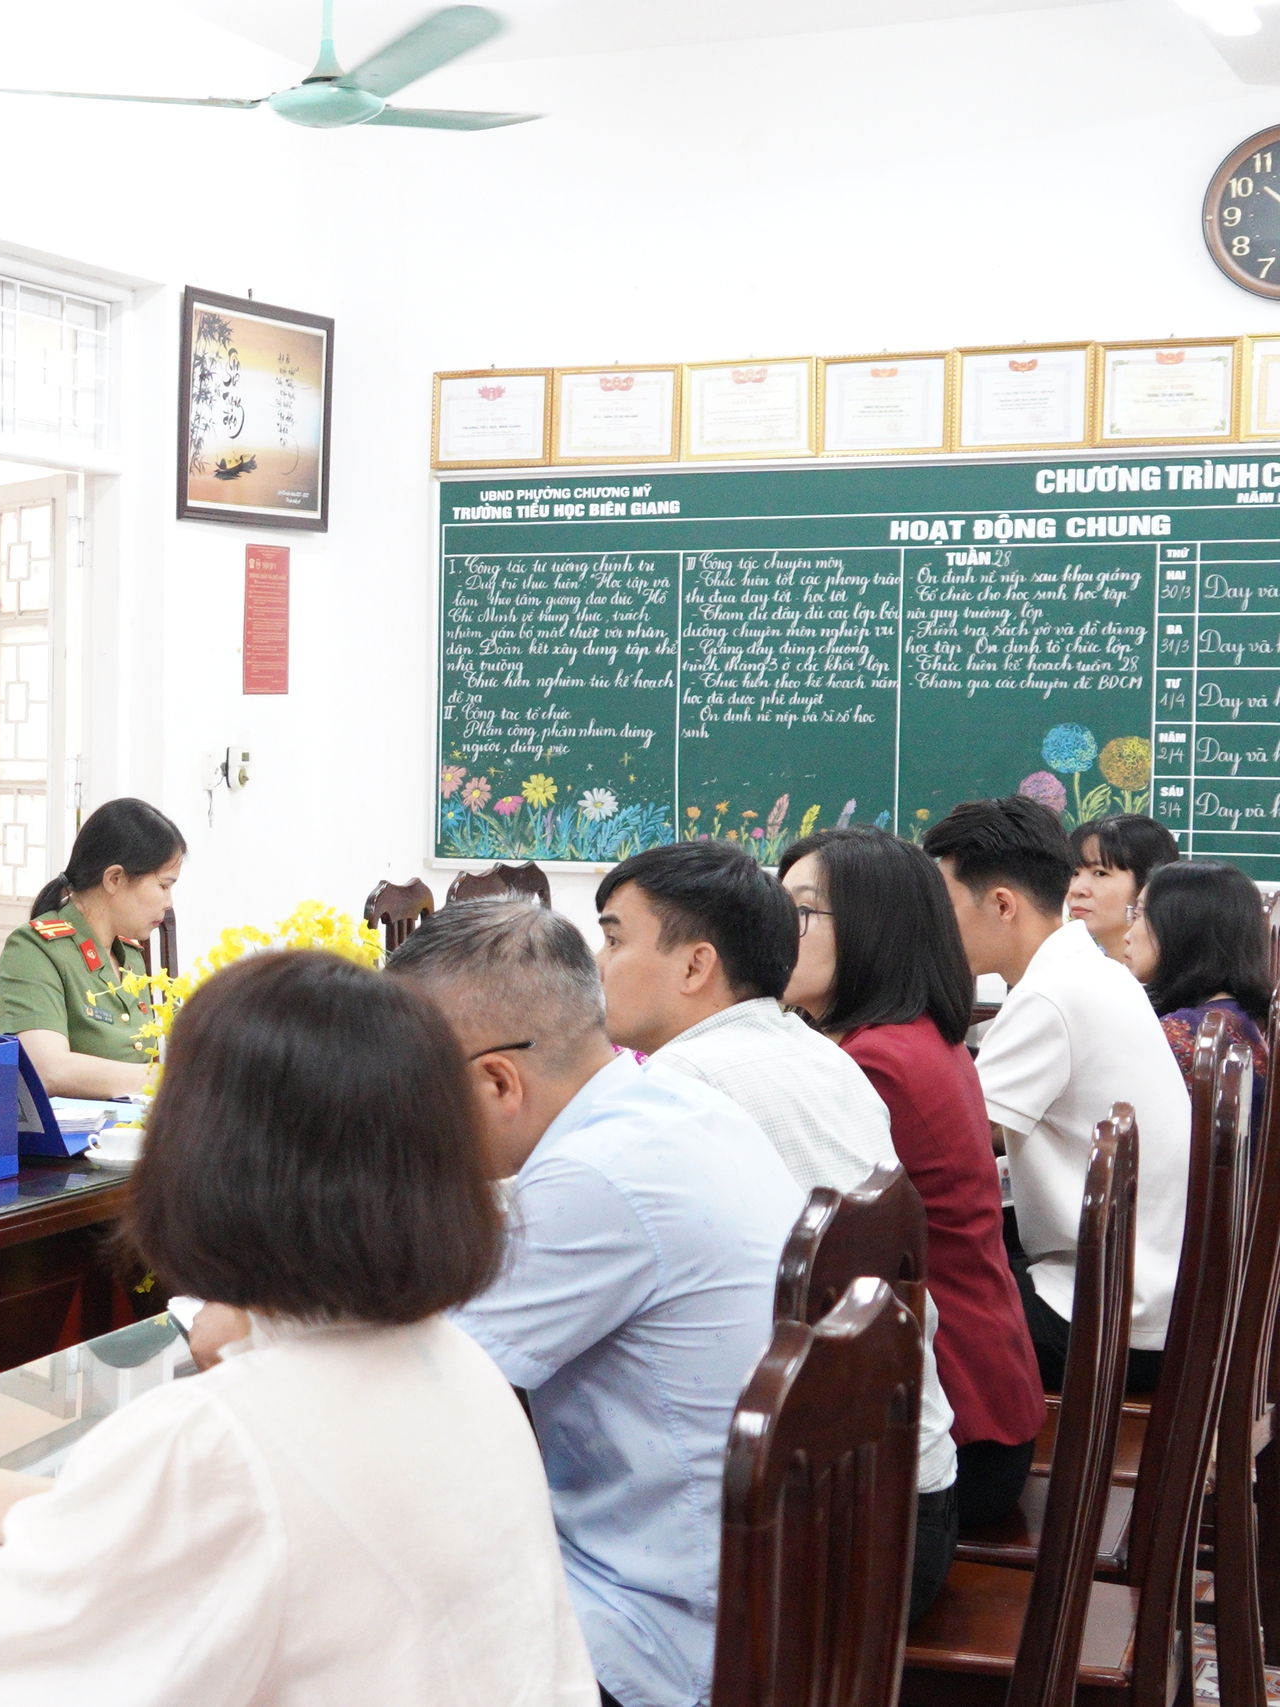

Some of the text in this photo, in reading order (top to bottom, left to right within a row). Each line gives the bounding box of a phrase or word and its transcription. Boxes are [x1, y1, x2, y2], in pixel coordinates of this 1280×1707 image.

[1253, 151, 1272, 174] 11
[1229, 177, 1254, 198] 10
[1222, 206, 1242, 227] 9
[1232, 235, 1250, 256] 8
[1257, 257, 1276, 279] 7
[1036, 465, 1161, 494] CHƯƠNG
[1164, 459, 1259, 490] TRÌNH
[480, 483, 652, 502] UBND PHƯỜNG CHƯƠNG MỸ
[1236, 491, 1273, 504] NĂM
[452, 499, 680, 520] TRƯỜNG TIỂU HỌC BIÊN GIANG
[890, 514, 1171, 545] HOẠT ĐỘNG CHUNG
[945, 548, 1012, 567] TUẦN 28
[1166, 547, 1190, 558] THỨ
[465, 555, 502, 582] Công
[506, 560, 528, 574] tác
[532, 560, 548, 574] tư
[593, 554, 635, 572] chính
[638, 560, 656, 575] trị
[699, 552, 733, 579] Công
[738, 556, 761, 570] tác
[816, 556, 846, 569] môn
[1031, 564, 1094, 583] sau khai
[1166, 570, 1186, 580] HAI
[653, 576, 671, 588] và
[800, 567, 871, 595] các phong
[642, 588, 669, 605] Hồ
[685, 587, 737, 604] thi đua
[940, 584, 1069, 601] chức cho sinh
[1160, 584, 1191, 602] 30/3
[546, 596, 582, 614] gương
[448, 606, 651, 631] Chí Minh về trung trách
[699, 604, 803, 629] Tham đầy
[519, 622, 668, 639] bó nhân
[732, 621, 817, 647] chuyên môn
[992, 620, 1030, 637] sách
[1166, 625, 1183, 635] BA
[446, 638, 579, 666] dân Đoàn xây
[1106, 636, 1133, 661] lớp
[1160, 638, 1190, 656] 31/3
[1248, 640, 1274, 654] và
[446, 655, 525, 679] nhà trường
[1004, 654, 1140, 672] kế 28
[589, 668, 675, 691] túc kế hoạch
[774, 672, 801, 688] theo
[915, 672, 1143, 700] Tham gia các chuyên đề BDCM
[1165, 678, 1182, 689] TƯ
[448, 690, 483, 704] đề ra
[760, 689, 786, 711] phê
[1160, 692, 1186, 711] 1/4
[462, 703, 498, 729] Công
[501, 707, 522, 721] tác
[526, 707, 542, 721] tổ
[542, 703, 572, 721] chức
[757, 709, 799, 730] nề nếp
[681, 722, 710, 739] sinh
[1159, 731, 1187, 743] NĂM
[1157, 747, 1185, 765] 2/4
[1160, 785, 1184, 797] SÁU
[1159, 802, 1182, 819] 3/4
[1245, 804, 1267, 818] và
